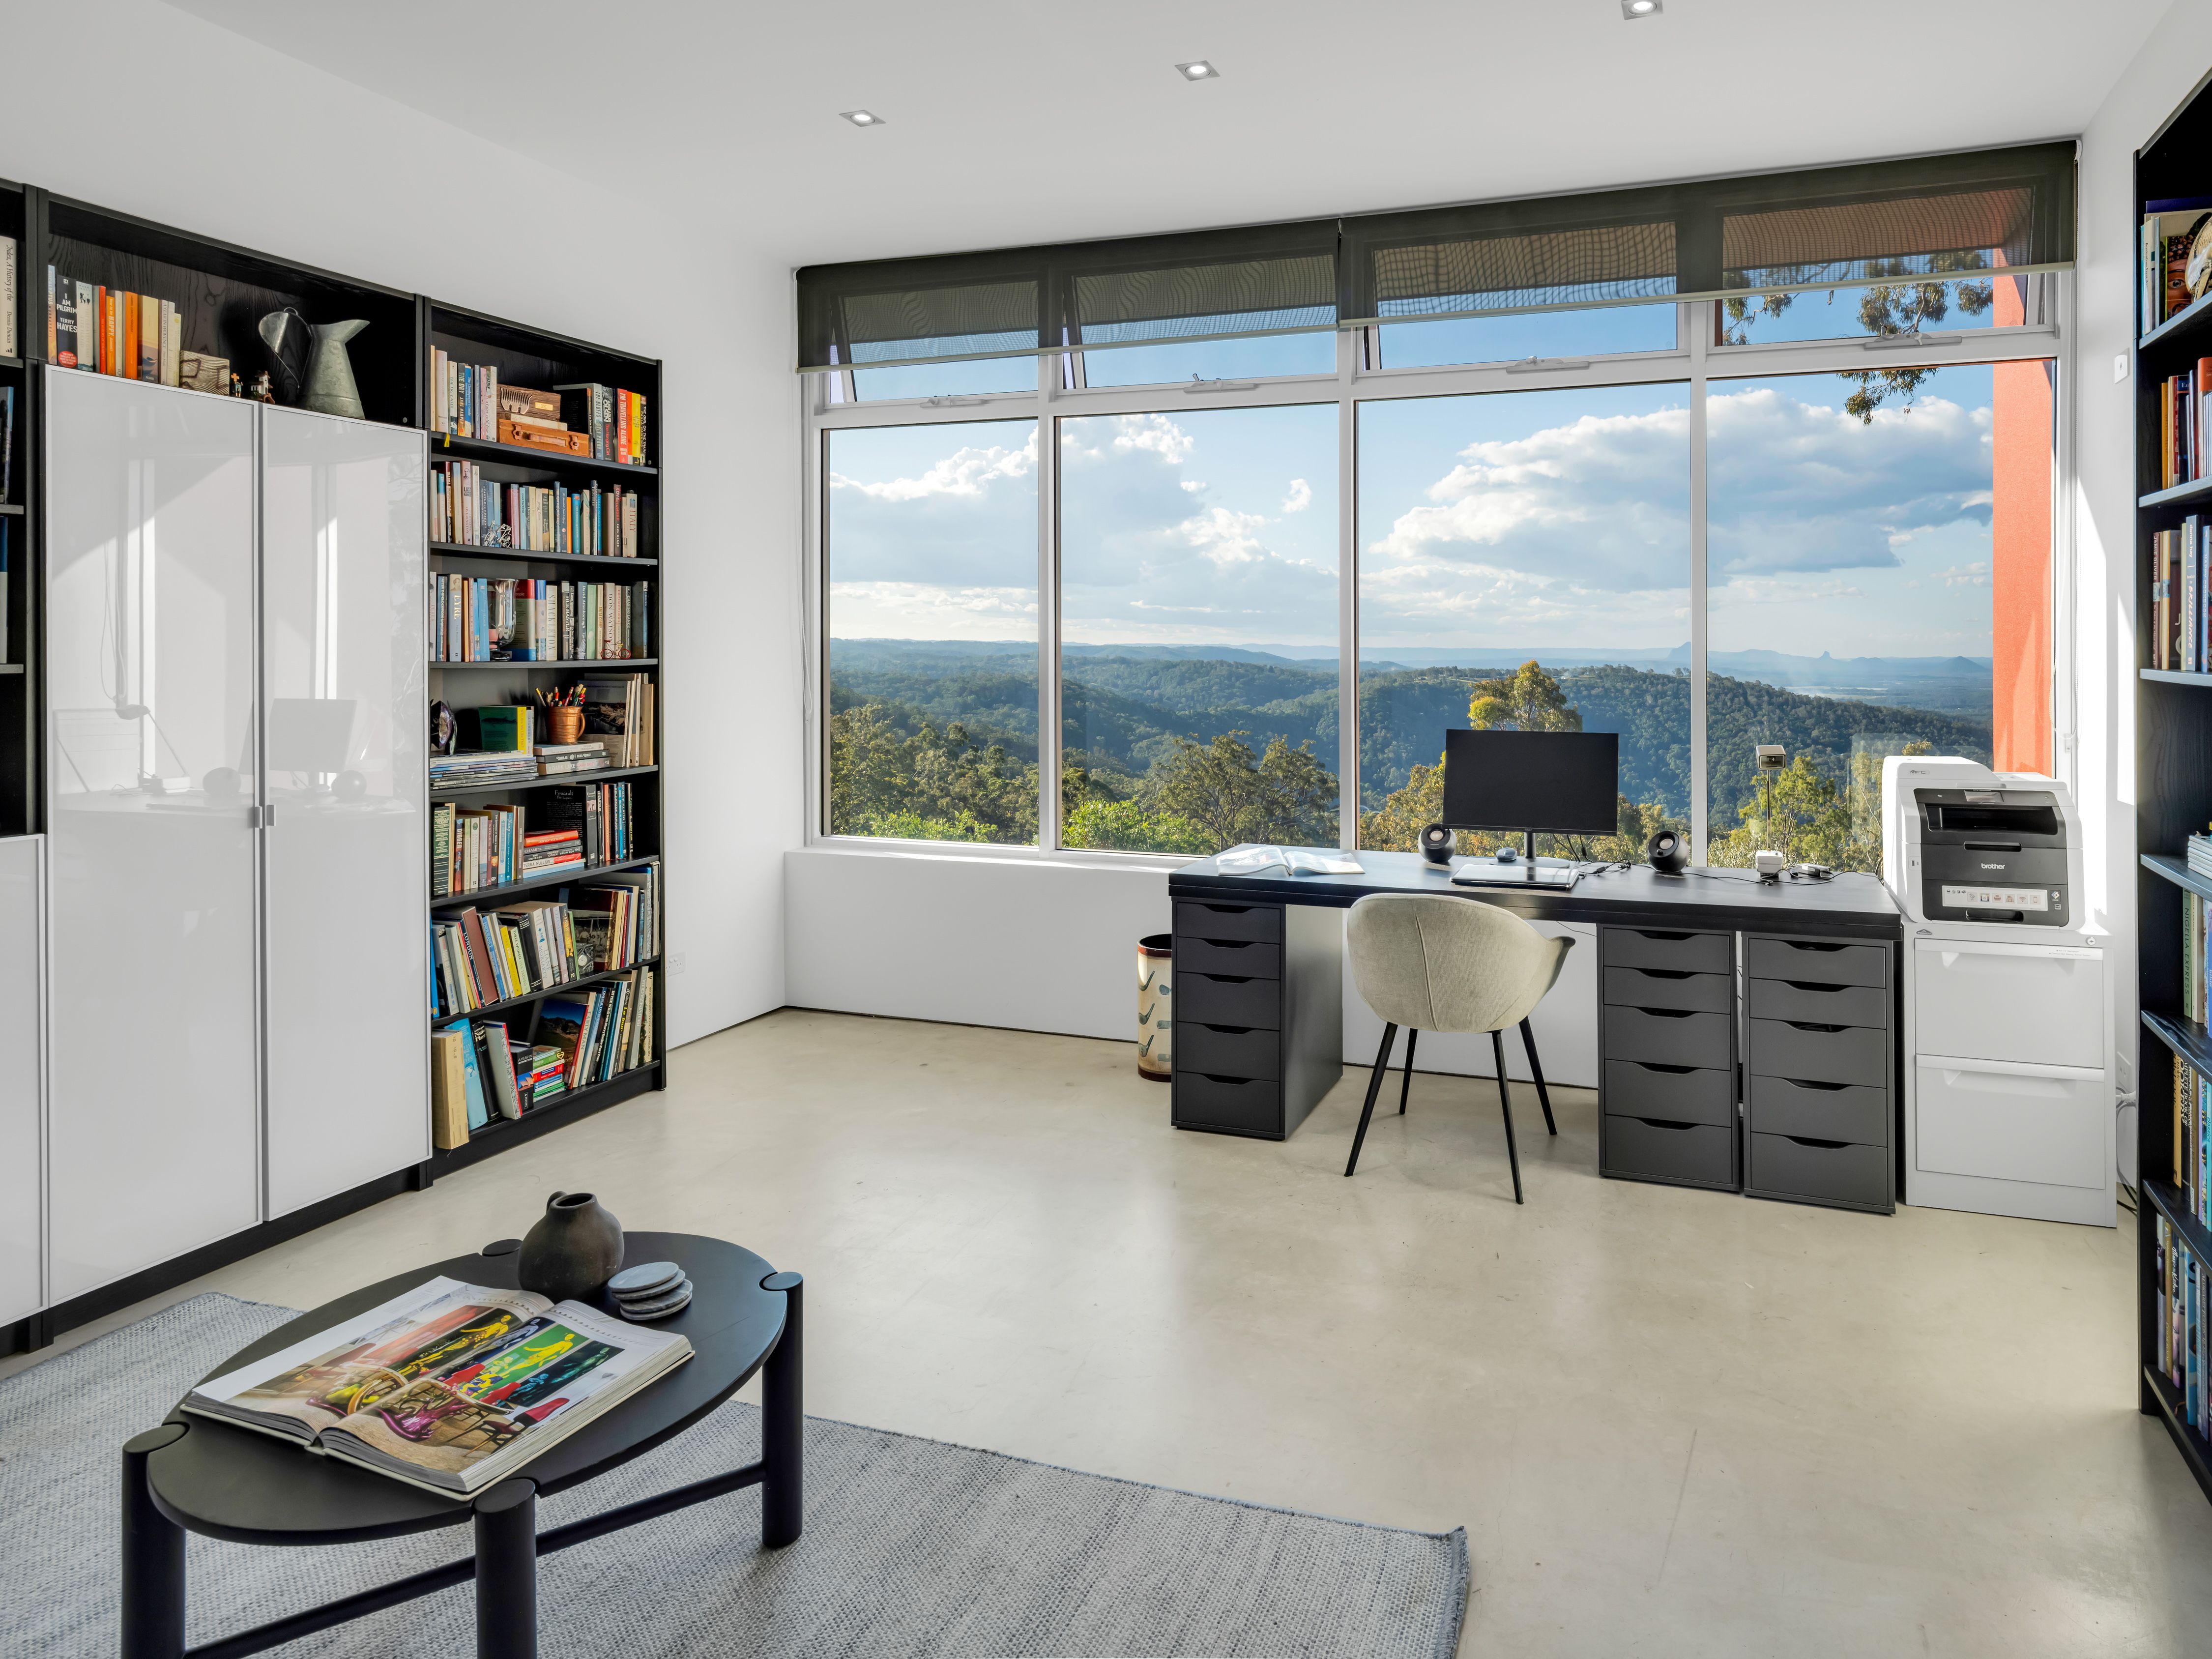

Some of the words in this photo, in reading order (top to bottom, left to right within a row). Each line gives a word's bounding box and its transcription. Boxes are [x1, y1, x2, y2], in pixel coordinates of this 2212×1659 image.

[4, 268, 13, 287] History
[57, 304, 77, 314] PILGRIM
[57, 323, 77, 332] HAYES
[463, 932, 473, 960] LONDON
[2184, 1116, 2187, 1127] OF
